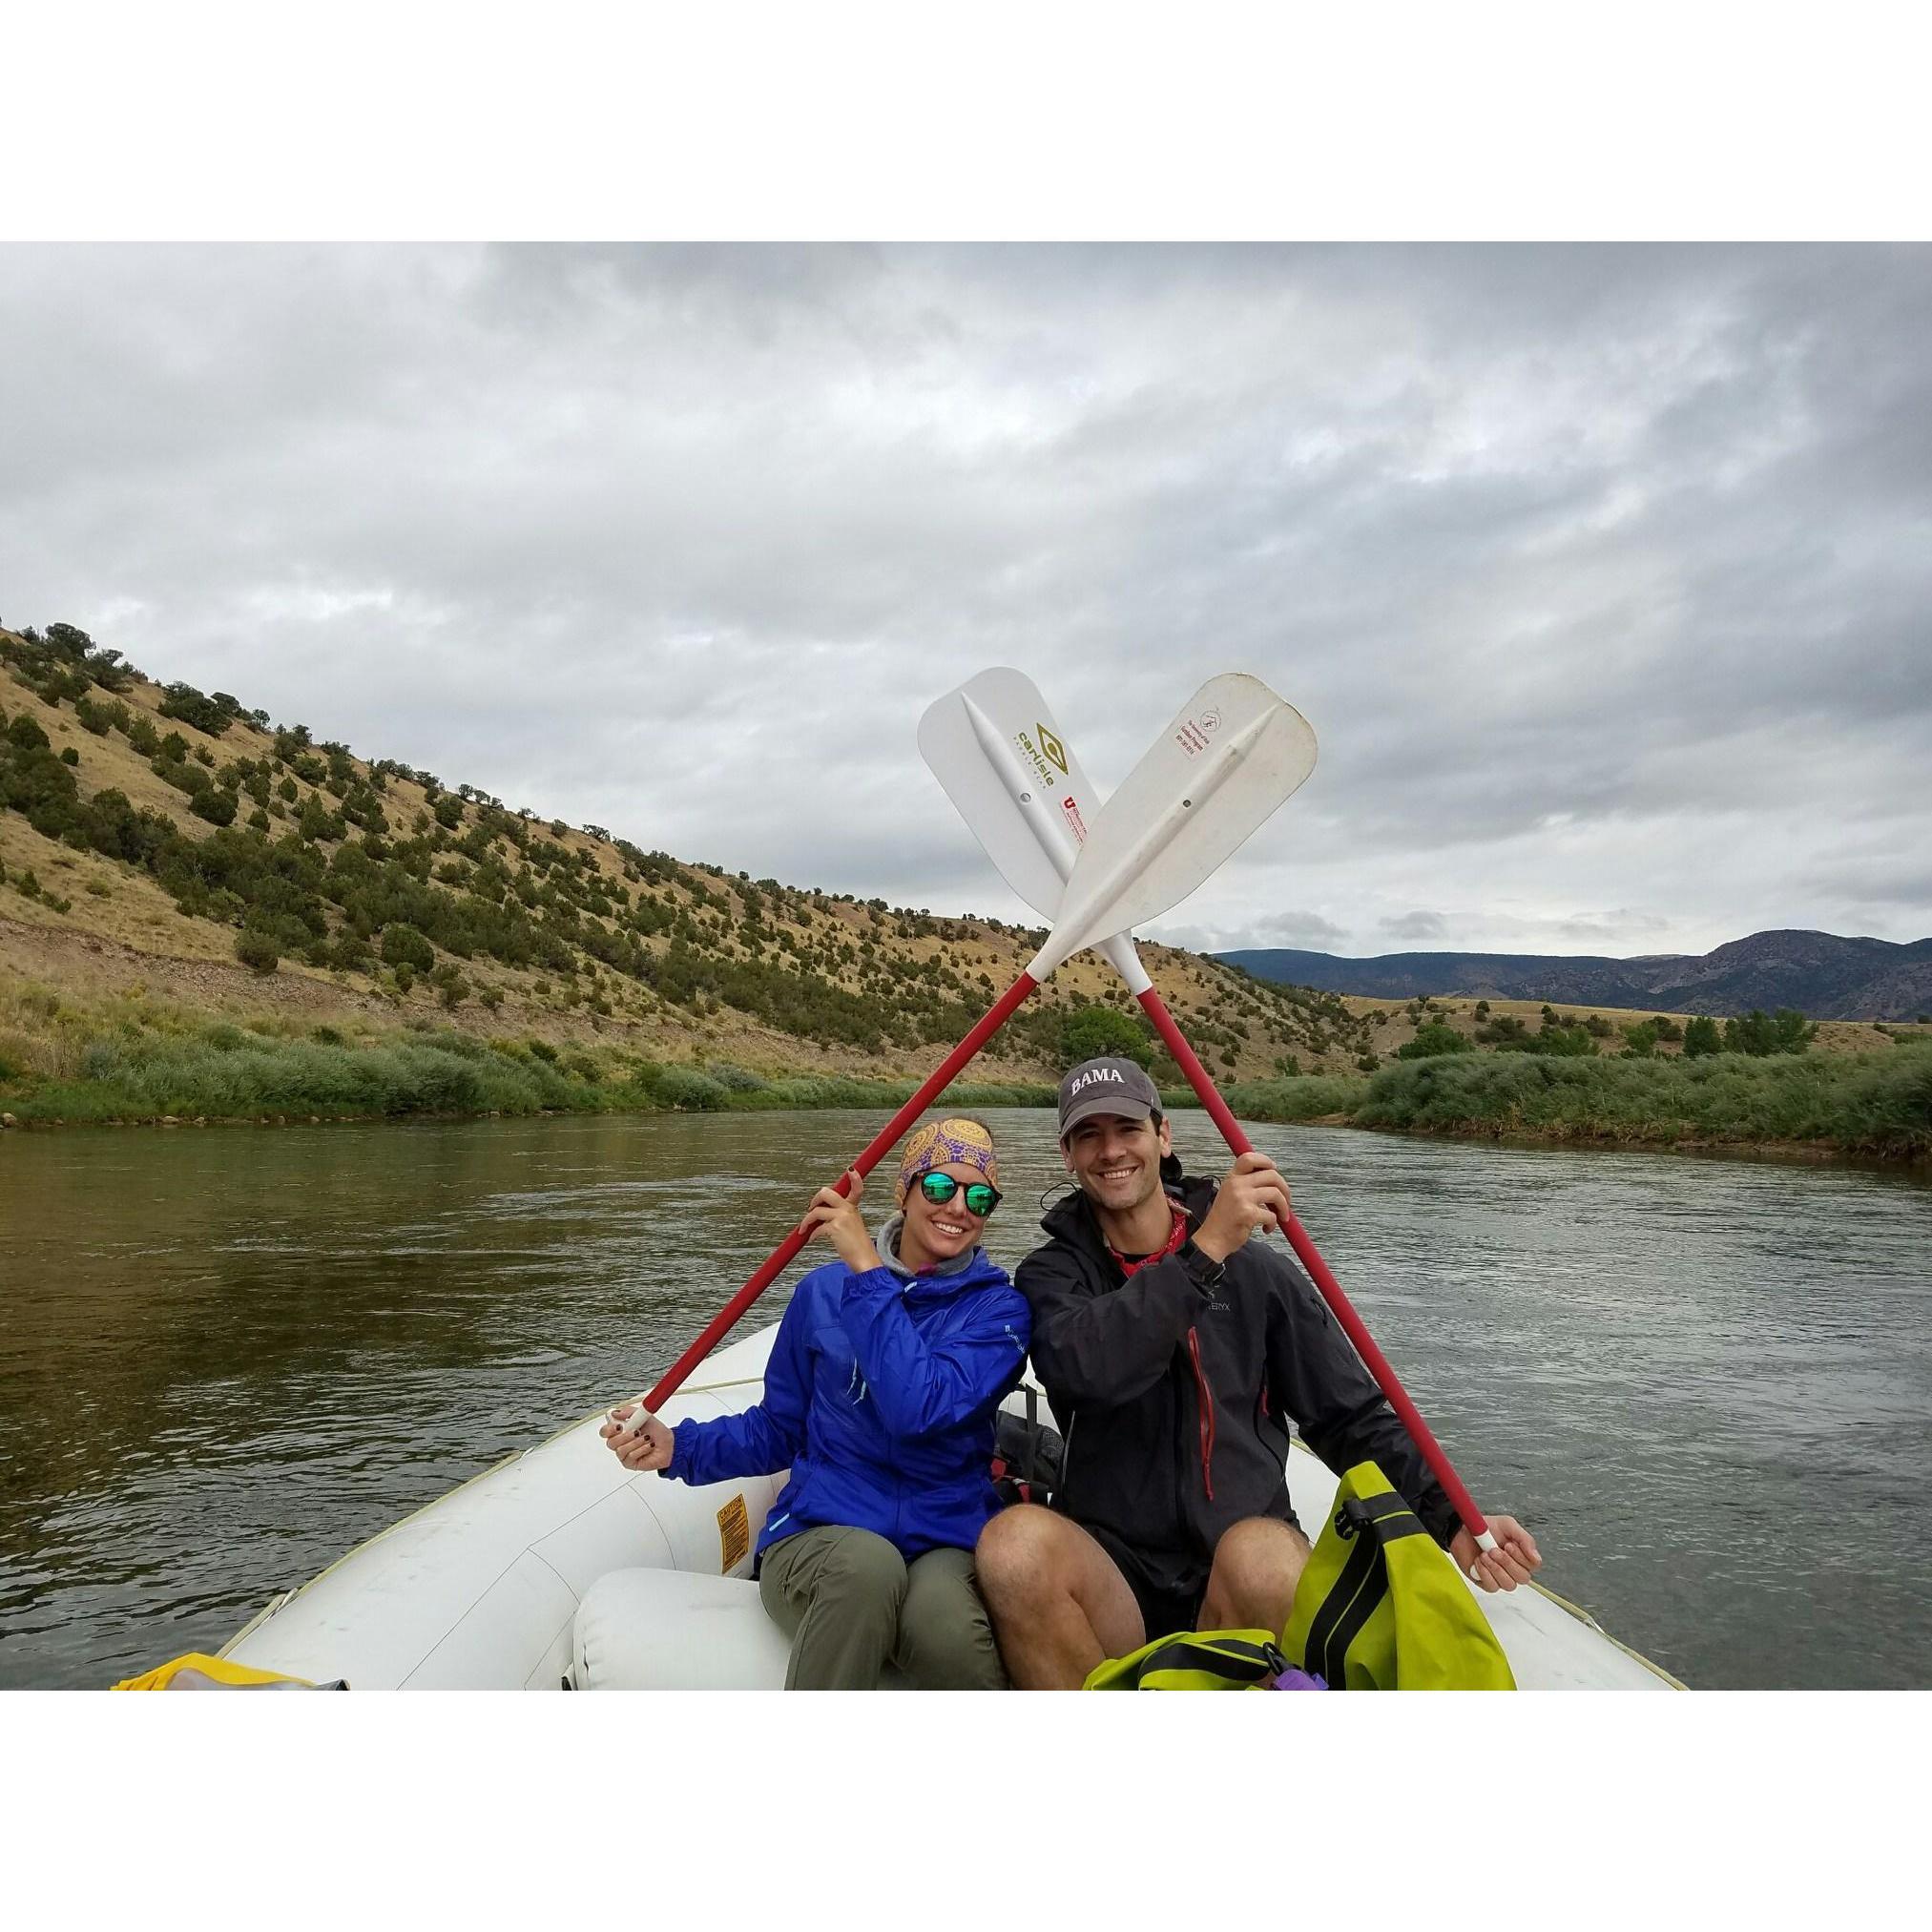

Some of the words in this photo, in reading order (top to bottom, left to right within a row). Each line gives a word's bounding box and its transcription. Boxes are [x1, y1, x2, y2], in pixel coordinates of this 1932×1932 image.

[1018, 732, 1054, 786] carlisle
[1064, 797, 1076, 809] U
[1070, 1068, 1125, 1096] BAMA
[719, 1496, 741, 1519] CAUTION
